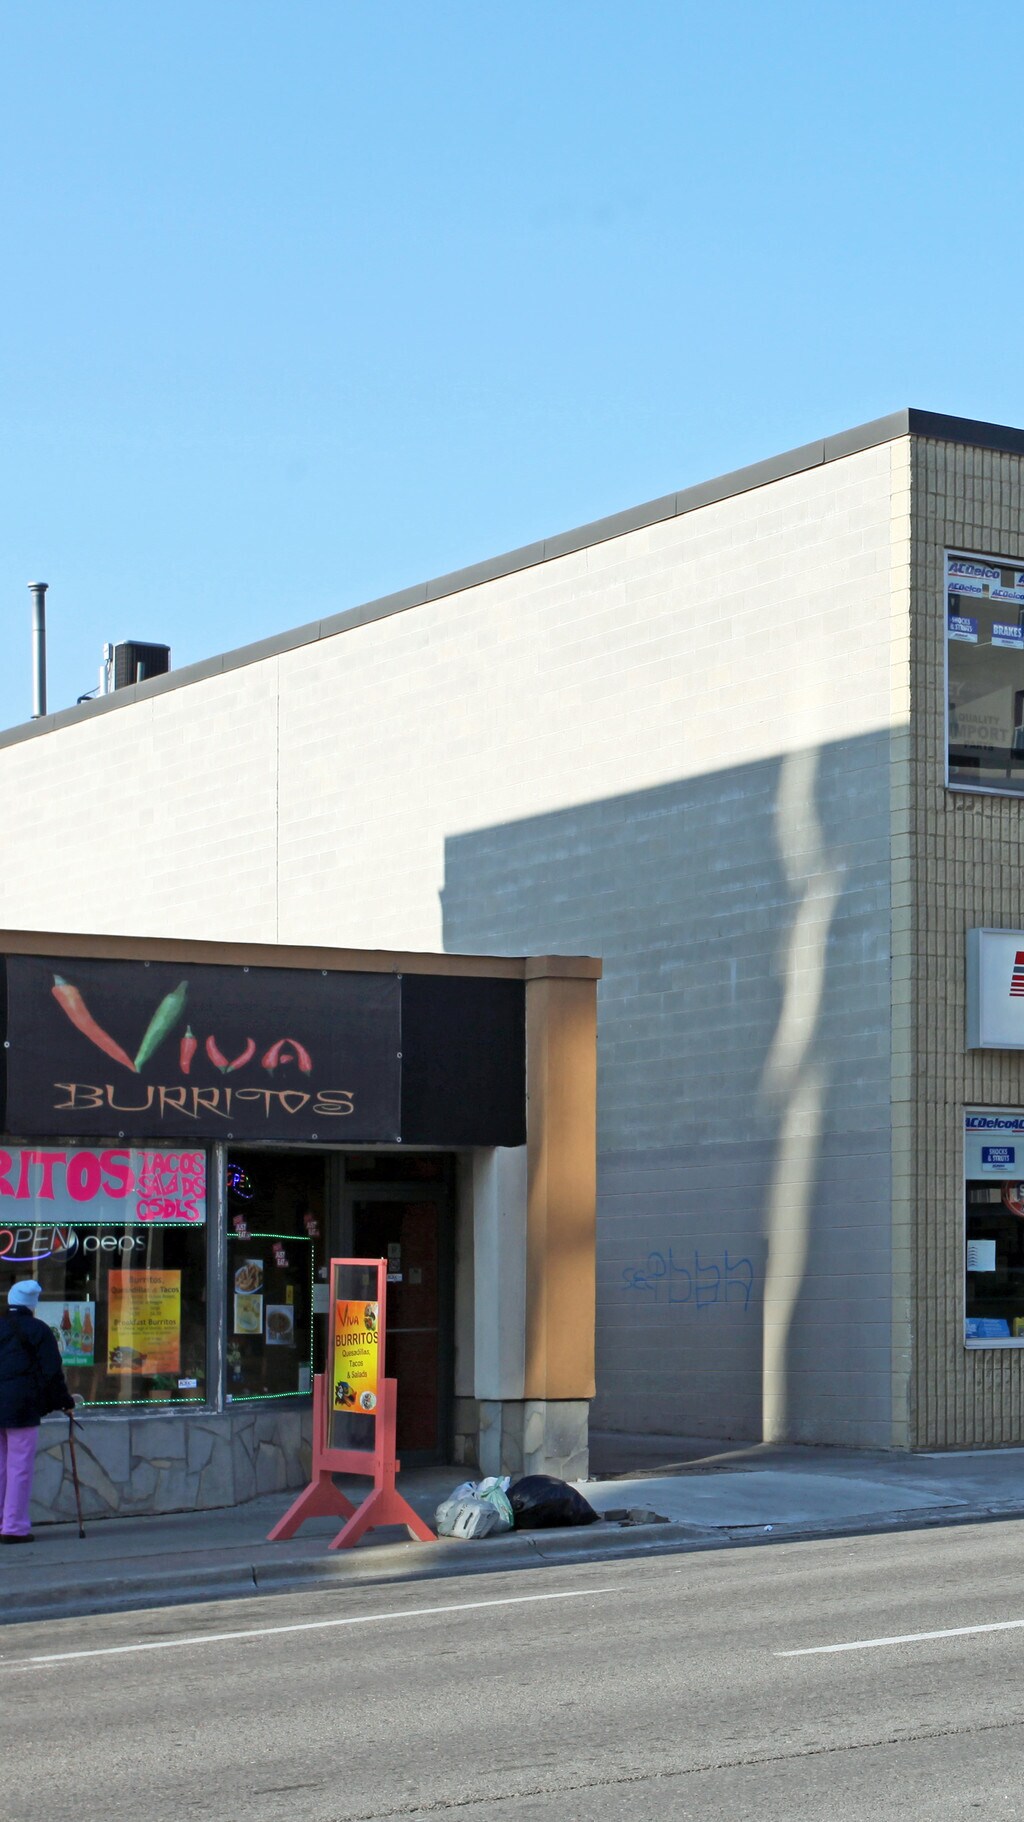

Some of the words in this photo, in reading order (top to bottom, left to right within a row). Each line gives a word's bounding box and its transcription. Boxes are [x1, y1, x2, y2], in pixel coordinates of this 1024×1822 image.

[949, 562, 1000, 579] ACDelco
[993, 624, 1022, 638] BRAKES
[53, 1083, 355, 1120] BURRITOS
[138, 1152, 205, 1175] TACOS
[137, 1173, 206, 1199] SALADS
[0, 1226, 72, 1254] OPEN
[161, 1286, 180, 1294] Tacos
[149, 1318, 177, 1326] Burritos
[335, 1331, 378, 1347] BURRITOS
[349, 1359, 364, 1368] Tacos
[351, 1370, 368, 1379] Salads
